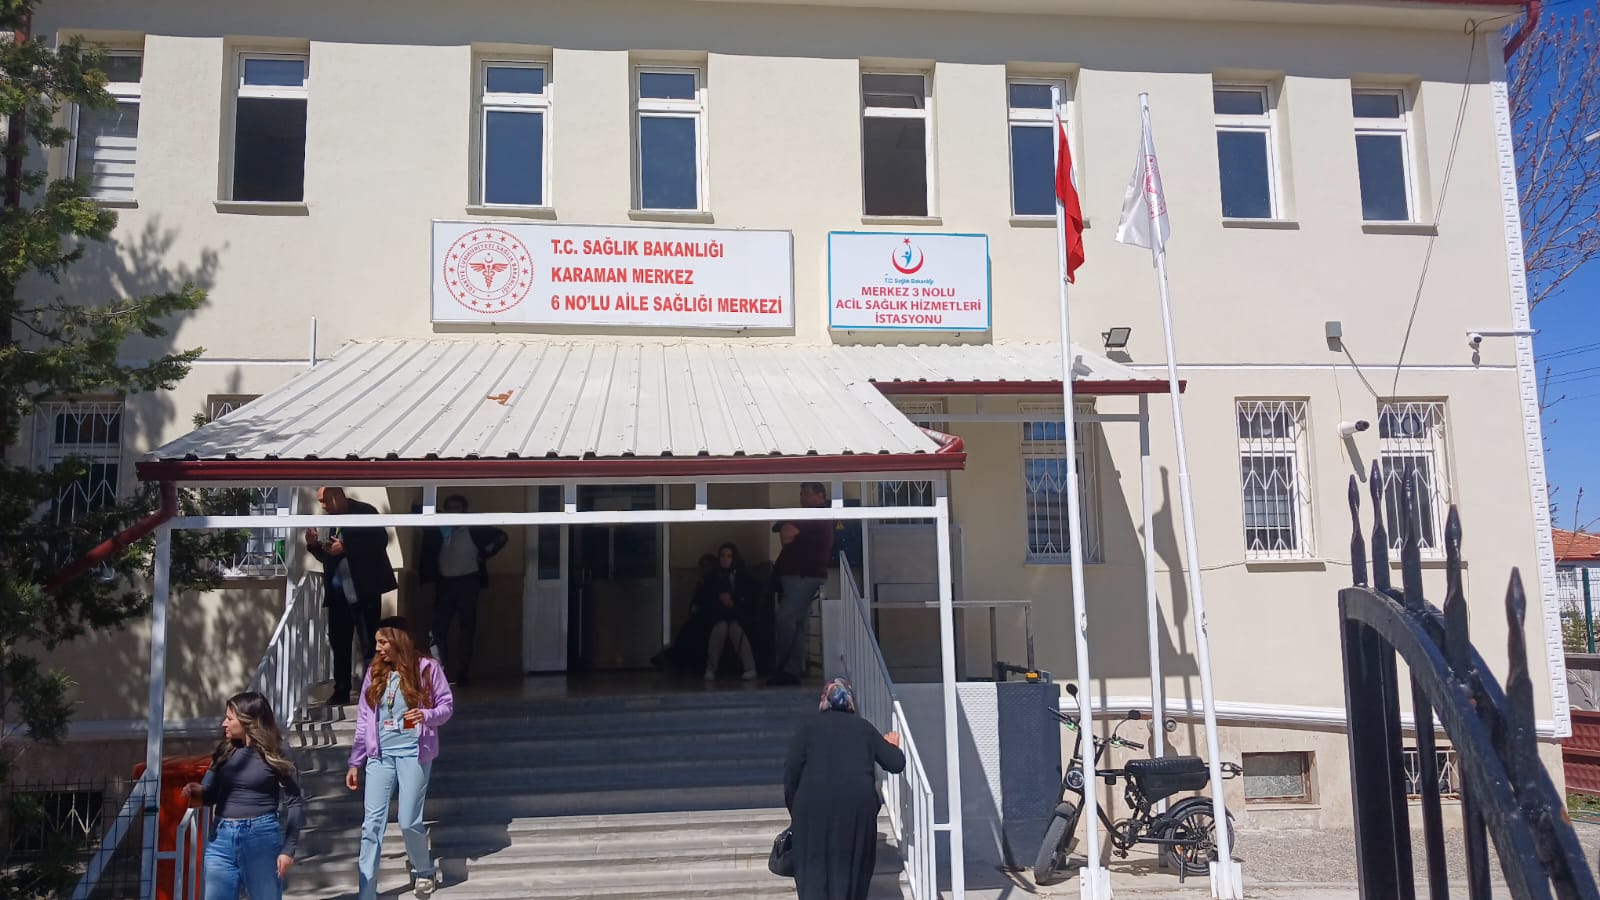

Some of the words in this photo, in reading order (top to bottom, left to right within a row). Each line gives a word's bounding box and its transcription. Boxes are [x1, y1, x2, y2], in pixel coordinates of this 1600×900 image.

[551, 240, 578, 254] T.C.
[583, 237, 638, 256] SAĞLIK
[643, 239, 724, 258] BAKANLIĞI
[551, 267, 627, 283] KARAMAN
[631, 268, 694, 284] MERKEZ
[861, 287, 909, 297] MERKEZ
[912, 287, 919, 297] 3
[922, 287, 955, 297] NOLU
[551, 296, 560, 311] 6
[615, 293, 649, 312] AİLE
[653, 293, 713, 313] SAĞLIĞI
[717, 296, 782, 314] MERKEZİ
[836, 298, 862, 310] ACİL
[866, 298, 907, 311] SAĞLIK
[911, 299, 981, 311] HİZMETLERİ
[875, 312, 942, 324] İSTASYONU
